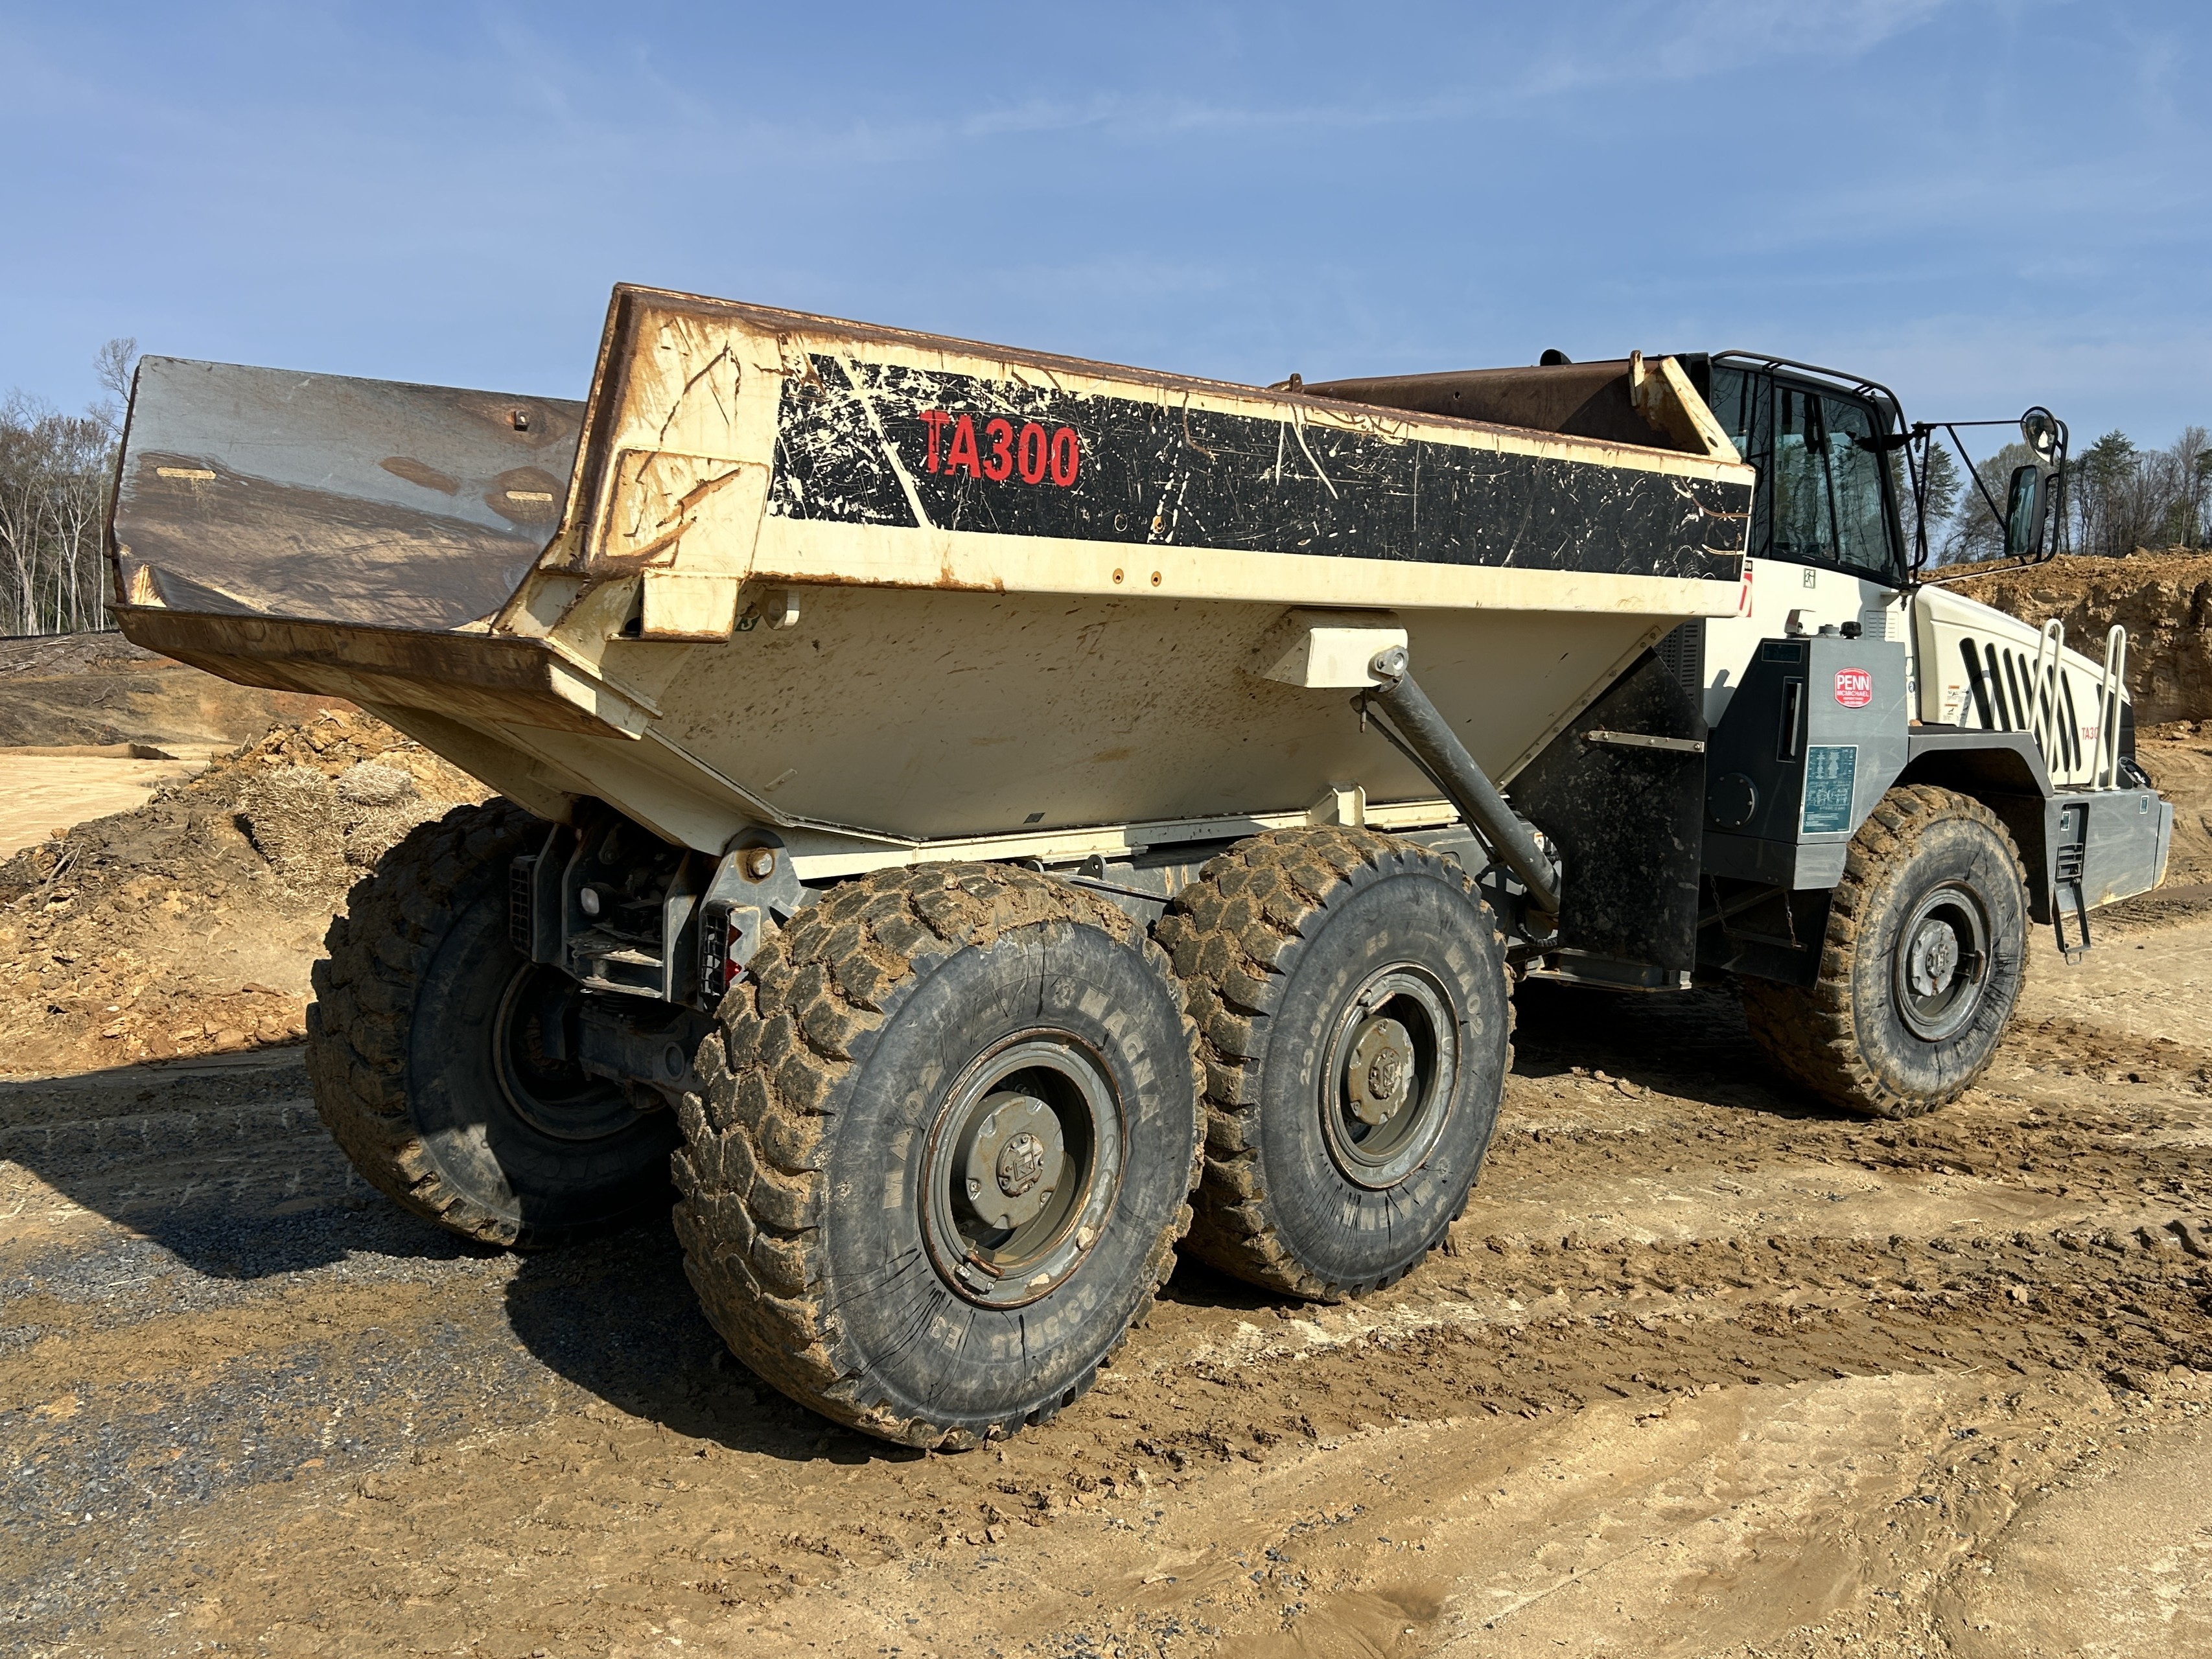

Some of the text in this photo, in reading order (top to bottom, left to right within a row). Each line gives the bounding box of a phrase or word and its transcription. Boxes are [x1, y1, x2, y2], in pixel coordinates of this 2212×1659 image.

[920, 410, 1080, 487] TA300
[1837, 675, 1870, 691] PENN
[1366, 929, 1388, 958] E3
[1078, 988, 1159, 1122] MAGNA
[1300, 969, 1347, 1085] 23.5R25
[883, 1059, 943, 1209] MA02
[929, 1315, 962, 1352] E3
[991, 1286, 1099, 1358] 23.5R25
